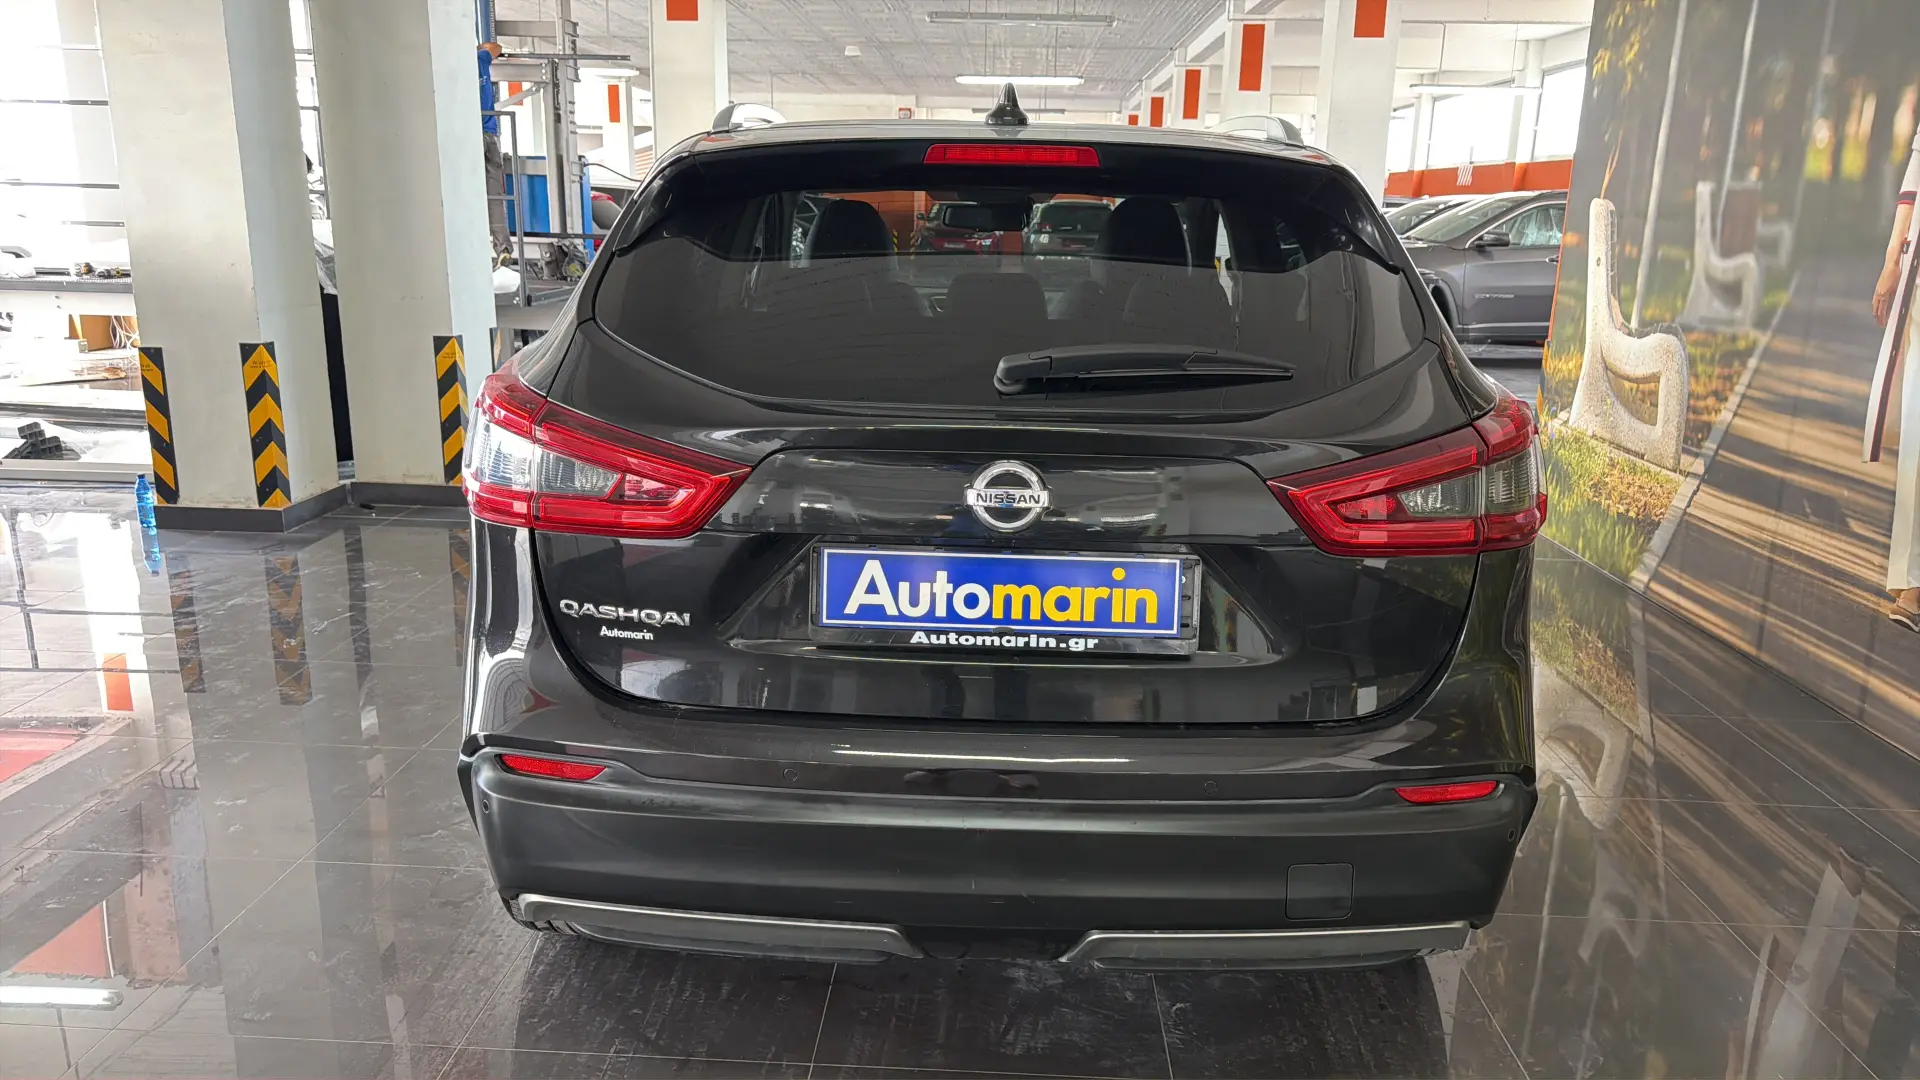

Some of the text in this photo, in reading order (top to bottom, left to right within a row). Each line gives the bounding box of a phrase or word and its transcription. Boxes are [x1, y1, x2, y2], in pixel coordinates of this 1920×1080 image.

[976, 493, 1041, 504] NISSAN
[843, 559, 1159, 624] Automarin
[559, 599, 691, 627] QASHQAI
[600, 625, 654, 641] Automarin
[909, 630, 1099, 652] Automarin.gr
